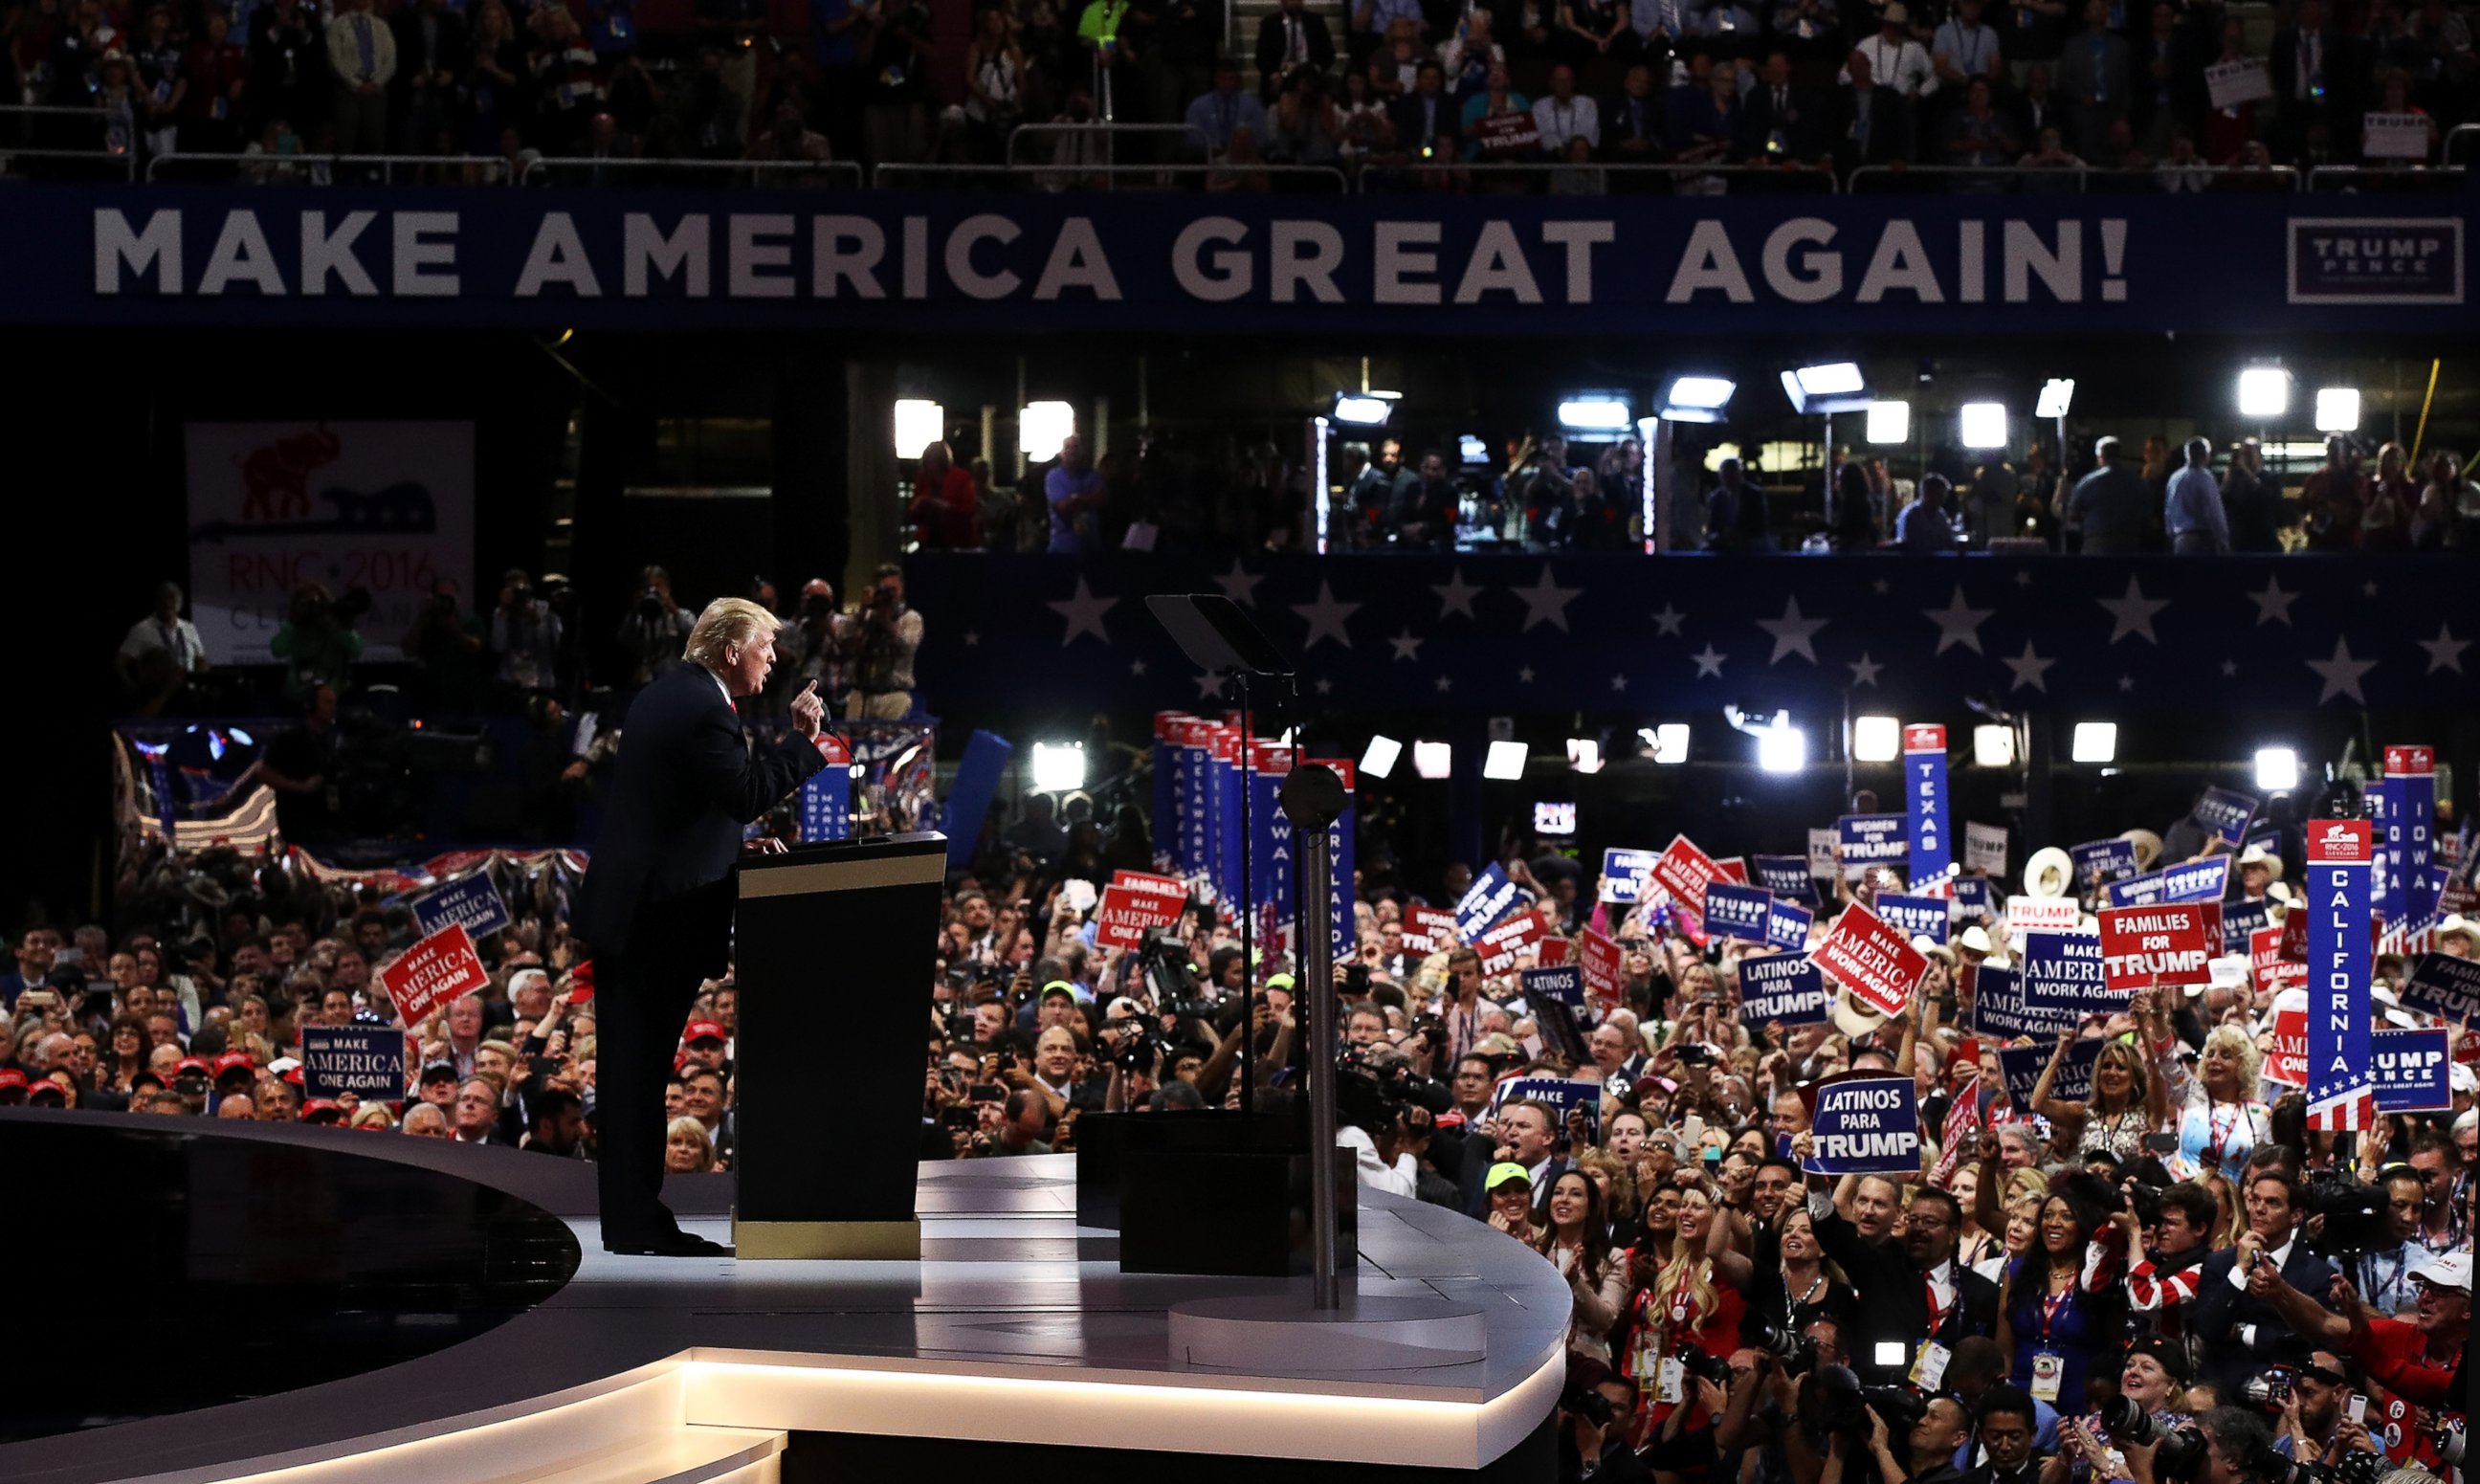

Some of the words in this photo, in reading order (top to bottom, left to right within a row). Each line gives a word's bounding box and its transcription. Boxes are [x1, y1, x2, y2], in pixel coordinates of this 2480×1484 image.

[94, 208, 460, 296] MAKE
[514, 212, 1123, 301] AMERICA
[1170, 216, 1616, 305] GREAT
[1665, 216, 2130, 305] AGAIN!
[2312, 238, 2441, 258] TRUMP
[2322, 259, 2427, 274] PENCE
[346, 549, 437, 593] 2016
[1191, 749, 1206, 862] DELAWARE
[1918, 763, 1938, 852] TEXAS
[1850, 819, 1898, 833] WOMEN
[1864, 832, 1885, 843] FOR
[2388, 802, 2402, 890] IOWA
[2412, 802, 2427, 890] IOWA
[1327, 818, 1343, 944] ARYLAND
[1665, 853, 1707, 896] AMERI
[1761, 869, 1808, 881] TRUMP
[2118, 875, 2164, 898] WOMEN
[438, 889, 467, 909] MAKE
[1131, 897, 1160, 912] MAKE
[1707, 895, 1767, 915] TRUMP
[424, 891, 499, 934] AMERICA
[1459, 881, 1517, 941] TRUMP
[1877, 904, 1947, 922] TRUMP
[2011, 905, 2075, 919] TRUMP
[2224, 913, 2265, 931] UMP
[1481, 917, 1535, 946] WOMEN
[1770, 913, 1808, 934] UMP
[2114, 913, 2190, 935] FAMILIES
[1869, 929, 1901, 960] MAKE
[2063, 943, 2102, 958] MAKE
[2141, 935, 2171, 950] FOR
[407, 945, 437, 972] MAKE
[1829, 925, 1915, 998] AMERICA
[2105, 950, 2207, 978] TRUMP
[393, 945, 476, 1008] AMERICA
[1746, 959, 1810, 981] LATINOS
[1827, 944, 1863, 979] WORK
[1862, 972, 1904, 1006] AGAIN
[2026, 959, 2105, 982] AMERI
[2330, 869, 2350, 1073] CALIFORNIA
[408, 990, 432, 1013] ONE
[431, 967, 471, 997] AGAIN
[1761, 978, 1794, 994] PARA
[2034, 982, 2079, 998] WORK
[1743, 990, 1825, 1019] TRUMP
[1983, 1010, 2022, 1030] WORK
[333, 1038, 369, 1052] MAKE
[305, 1052, 402, 1074] AMERICA
[2370, 1051, 2444, 1070] UMP
[319, 1074, 344, 1088] ONE
[345, 1074, 392, 1089] AGAIN
[1525, 1089, 1564, 1103] MAKE
[1823, 1088, 1901, 1112] LATINOS
[1840, 1113, 1881, 1129] PARA
[1813, 1132, 1918, 1159] TRUMP
